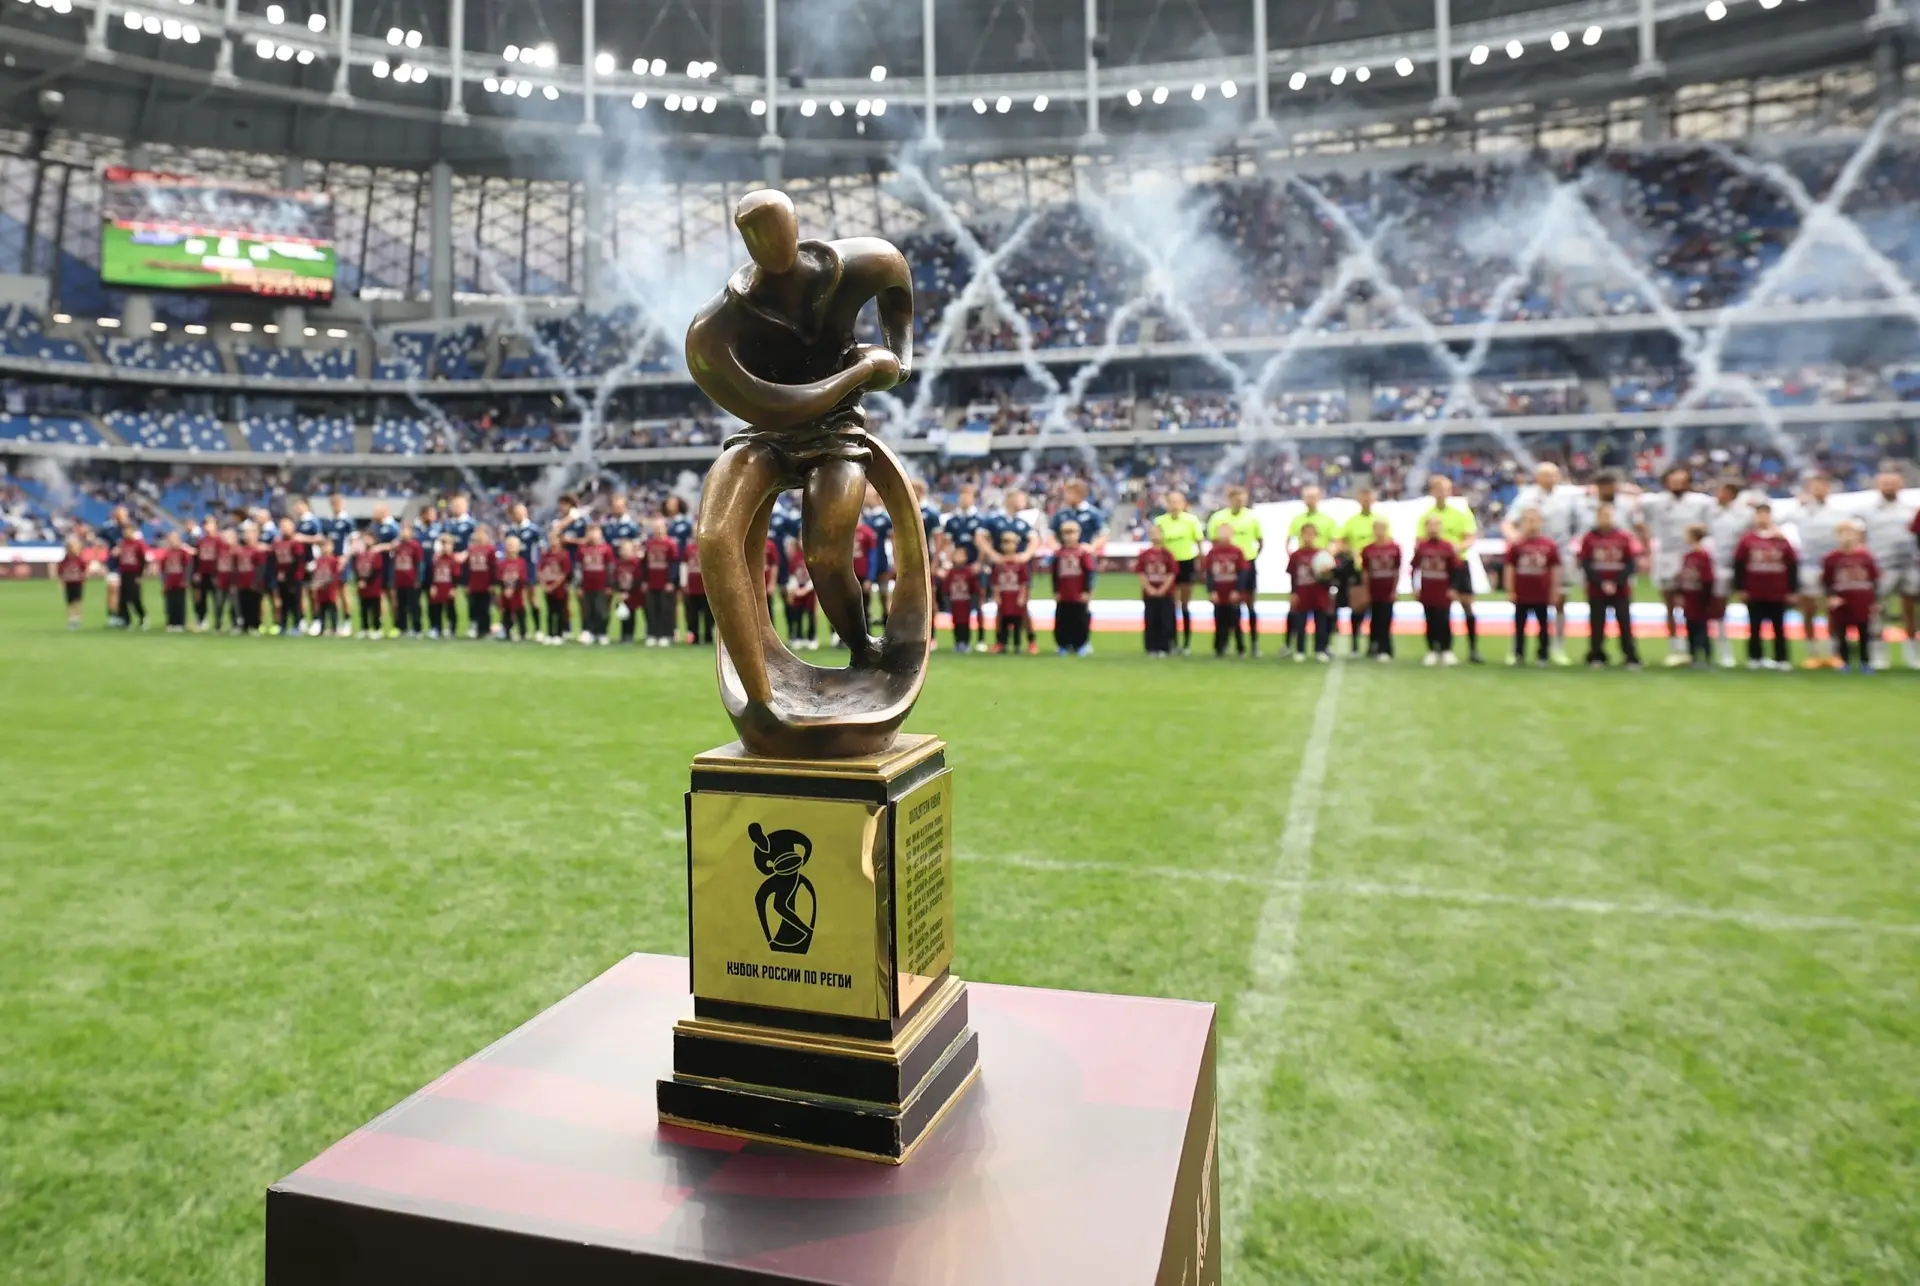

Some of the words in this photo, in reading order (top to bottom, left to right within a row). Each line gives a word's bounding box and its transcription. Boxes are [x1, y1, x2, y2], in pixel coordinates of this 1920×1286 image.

[727, 961, 759, 978] КУБОК
[762, 965, 801, 983] РОССИИ
[804, 970, 817, 984] ПО
[820, 972, 852, 988] РЕГБИ
